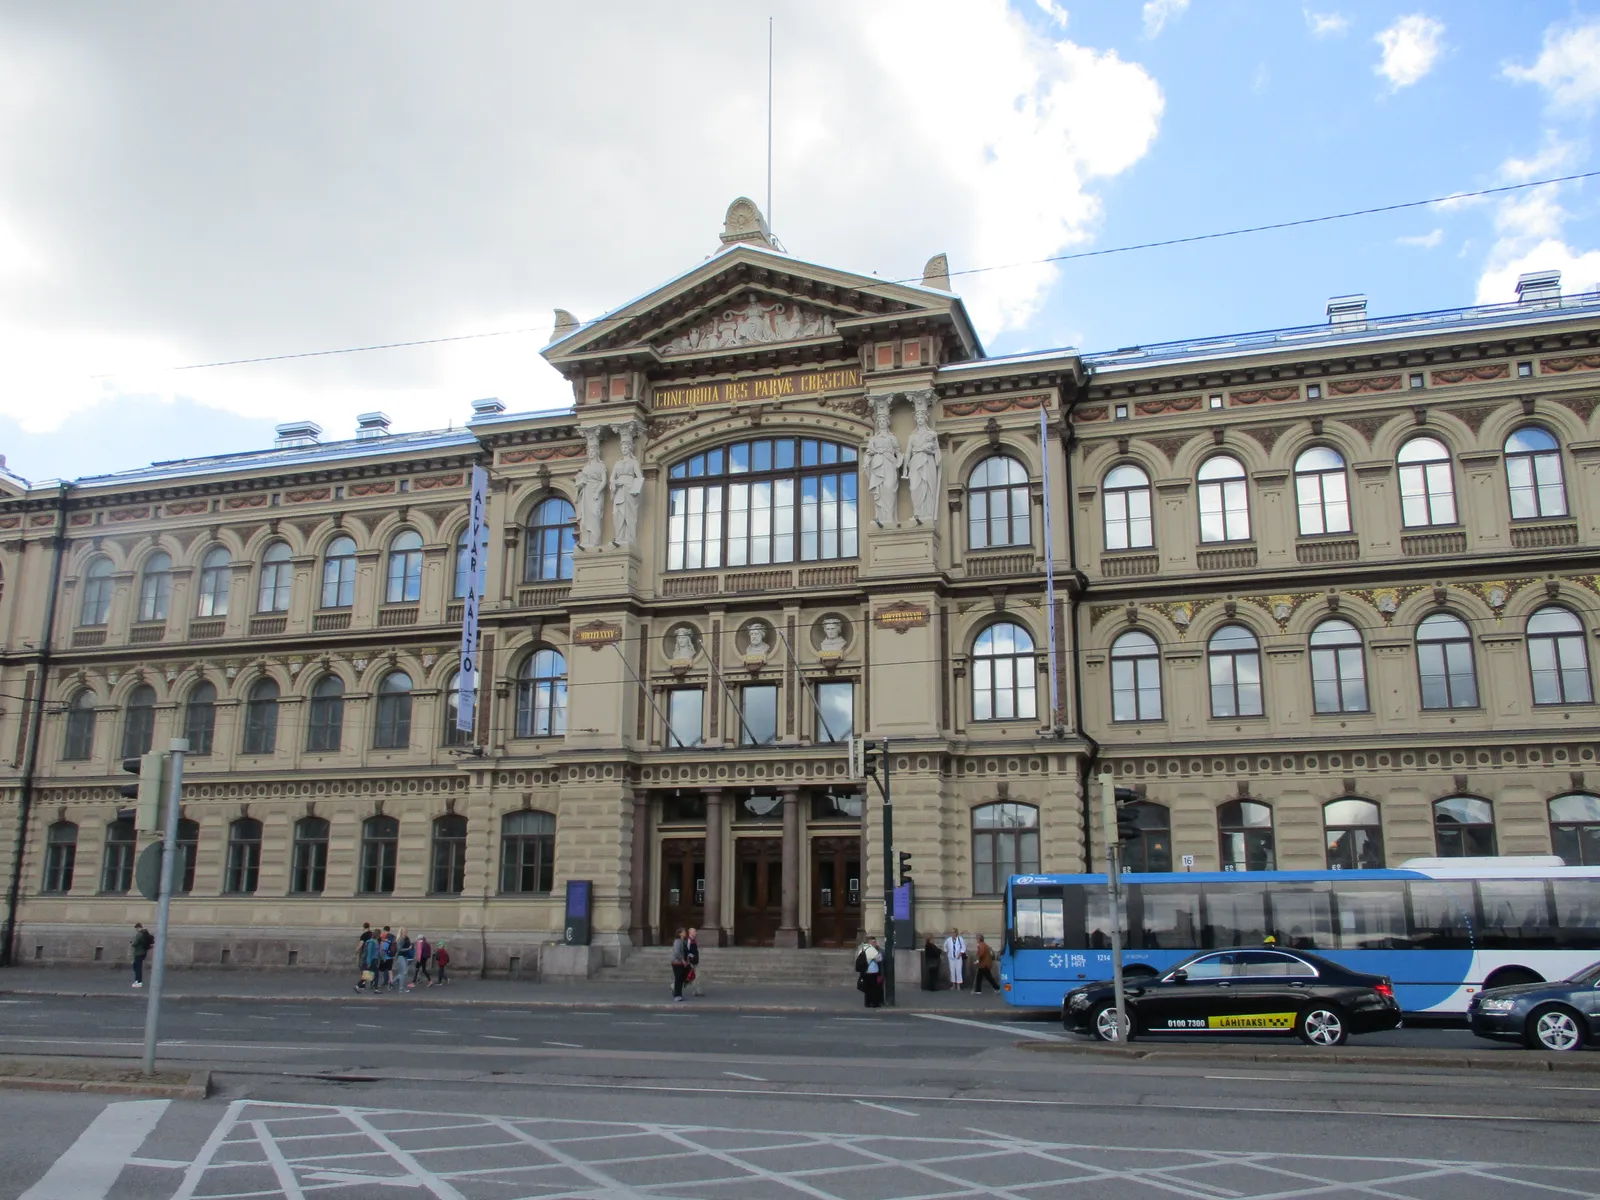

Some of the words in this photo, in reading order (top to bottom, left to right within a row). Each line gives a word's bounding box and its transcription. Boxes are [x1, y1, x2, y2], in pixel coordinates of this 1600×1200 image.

[656, 385, 719, 407] CONCORDIA
[725, 383, 748, 400] RES
[470, 490, 482, 573] ALVAR
[463, 586, 475, 673] AALTO
[1183, 857, 1192, 865] 16
[1220, 1017, 1266, 1027] LÄHITAKSI
